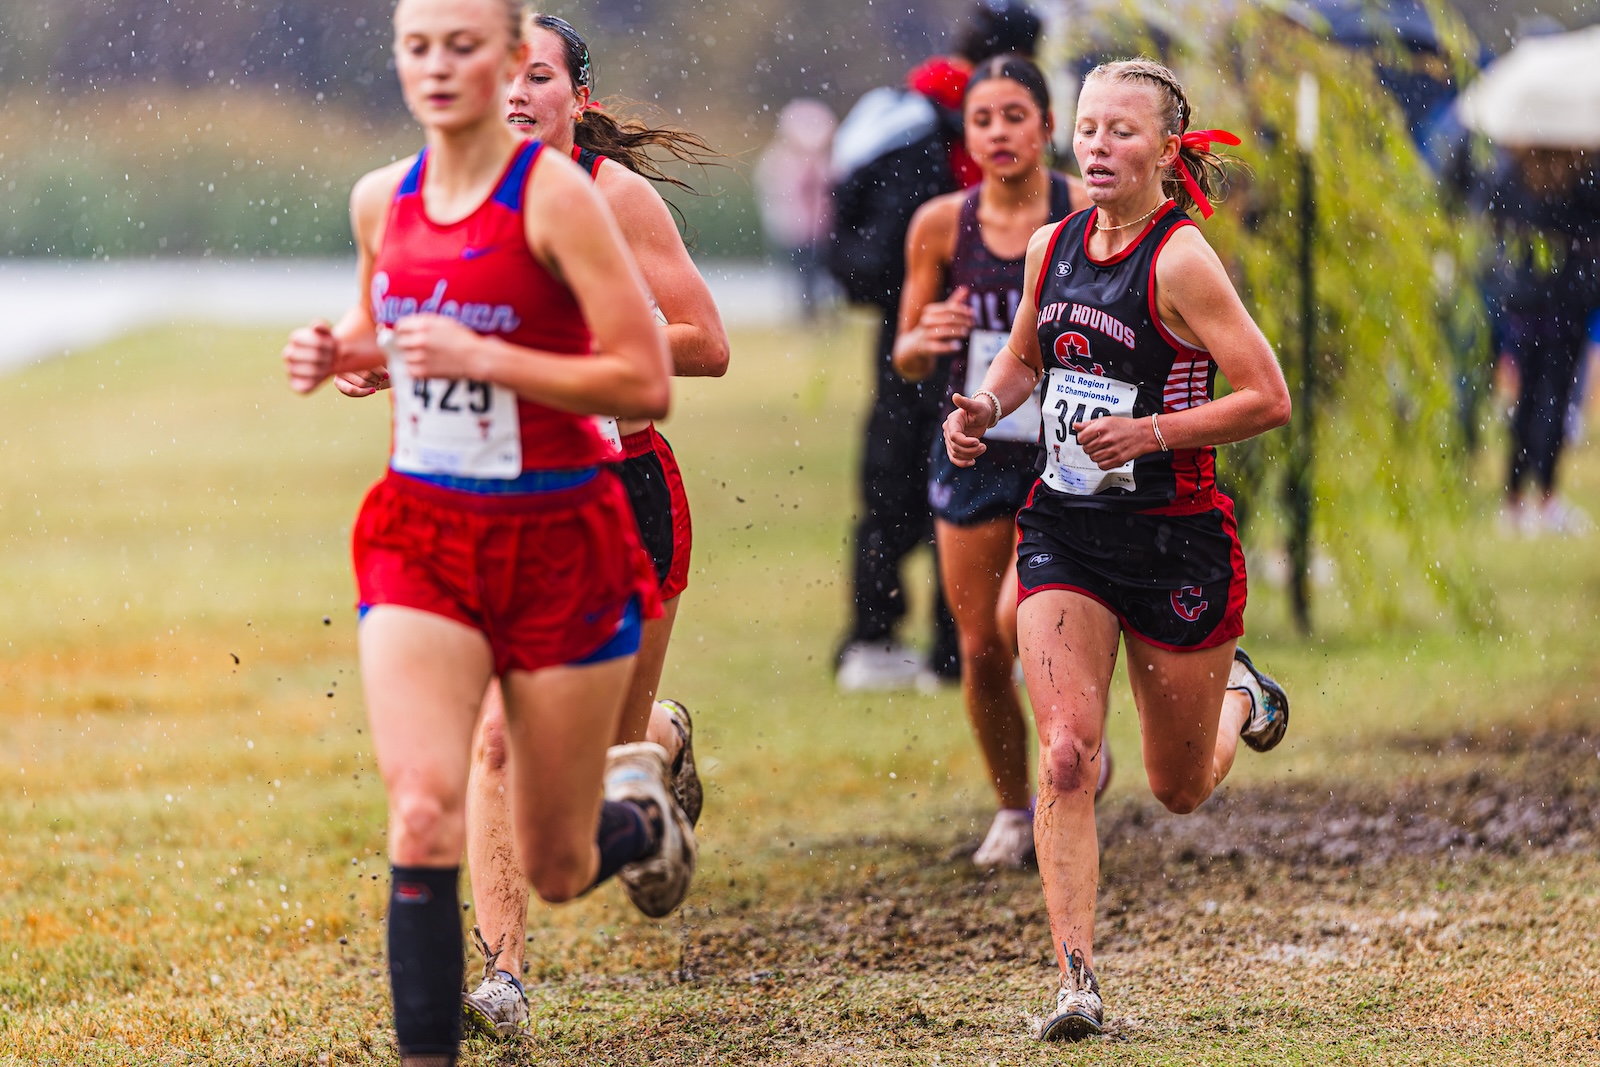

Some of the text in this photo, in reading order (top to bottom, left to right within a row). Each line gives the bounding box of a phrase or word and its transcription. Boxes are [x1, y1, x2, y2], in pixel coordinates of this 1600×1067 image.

[371, 271, 521, 333] Sundown
[1037, 302, 1068, 330] LADY
[1069, 303, 1136, 350] HOUNDS
[413, 377, 492, 415] 425
[1056, 384, 1120, 405] XC Championship
[1064, 374, 1076, 384] UIL
[1077, 377, 1105, 390] Region
